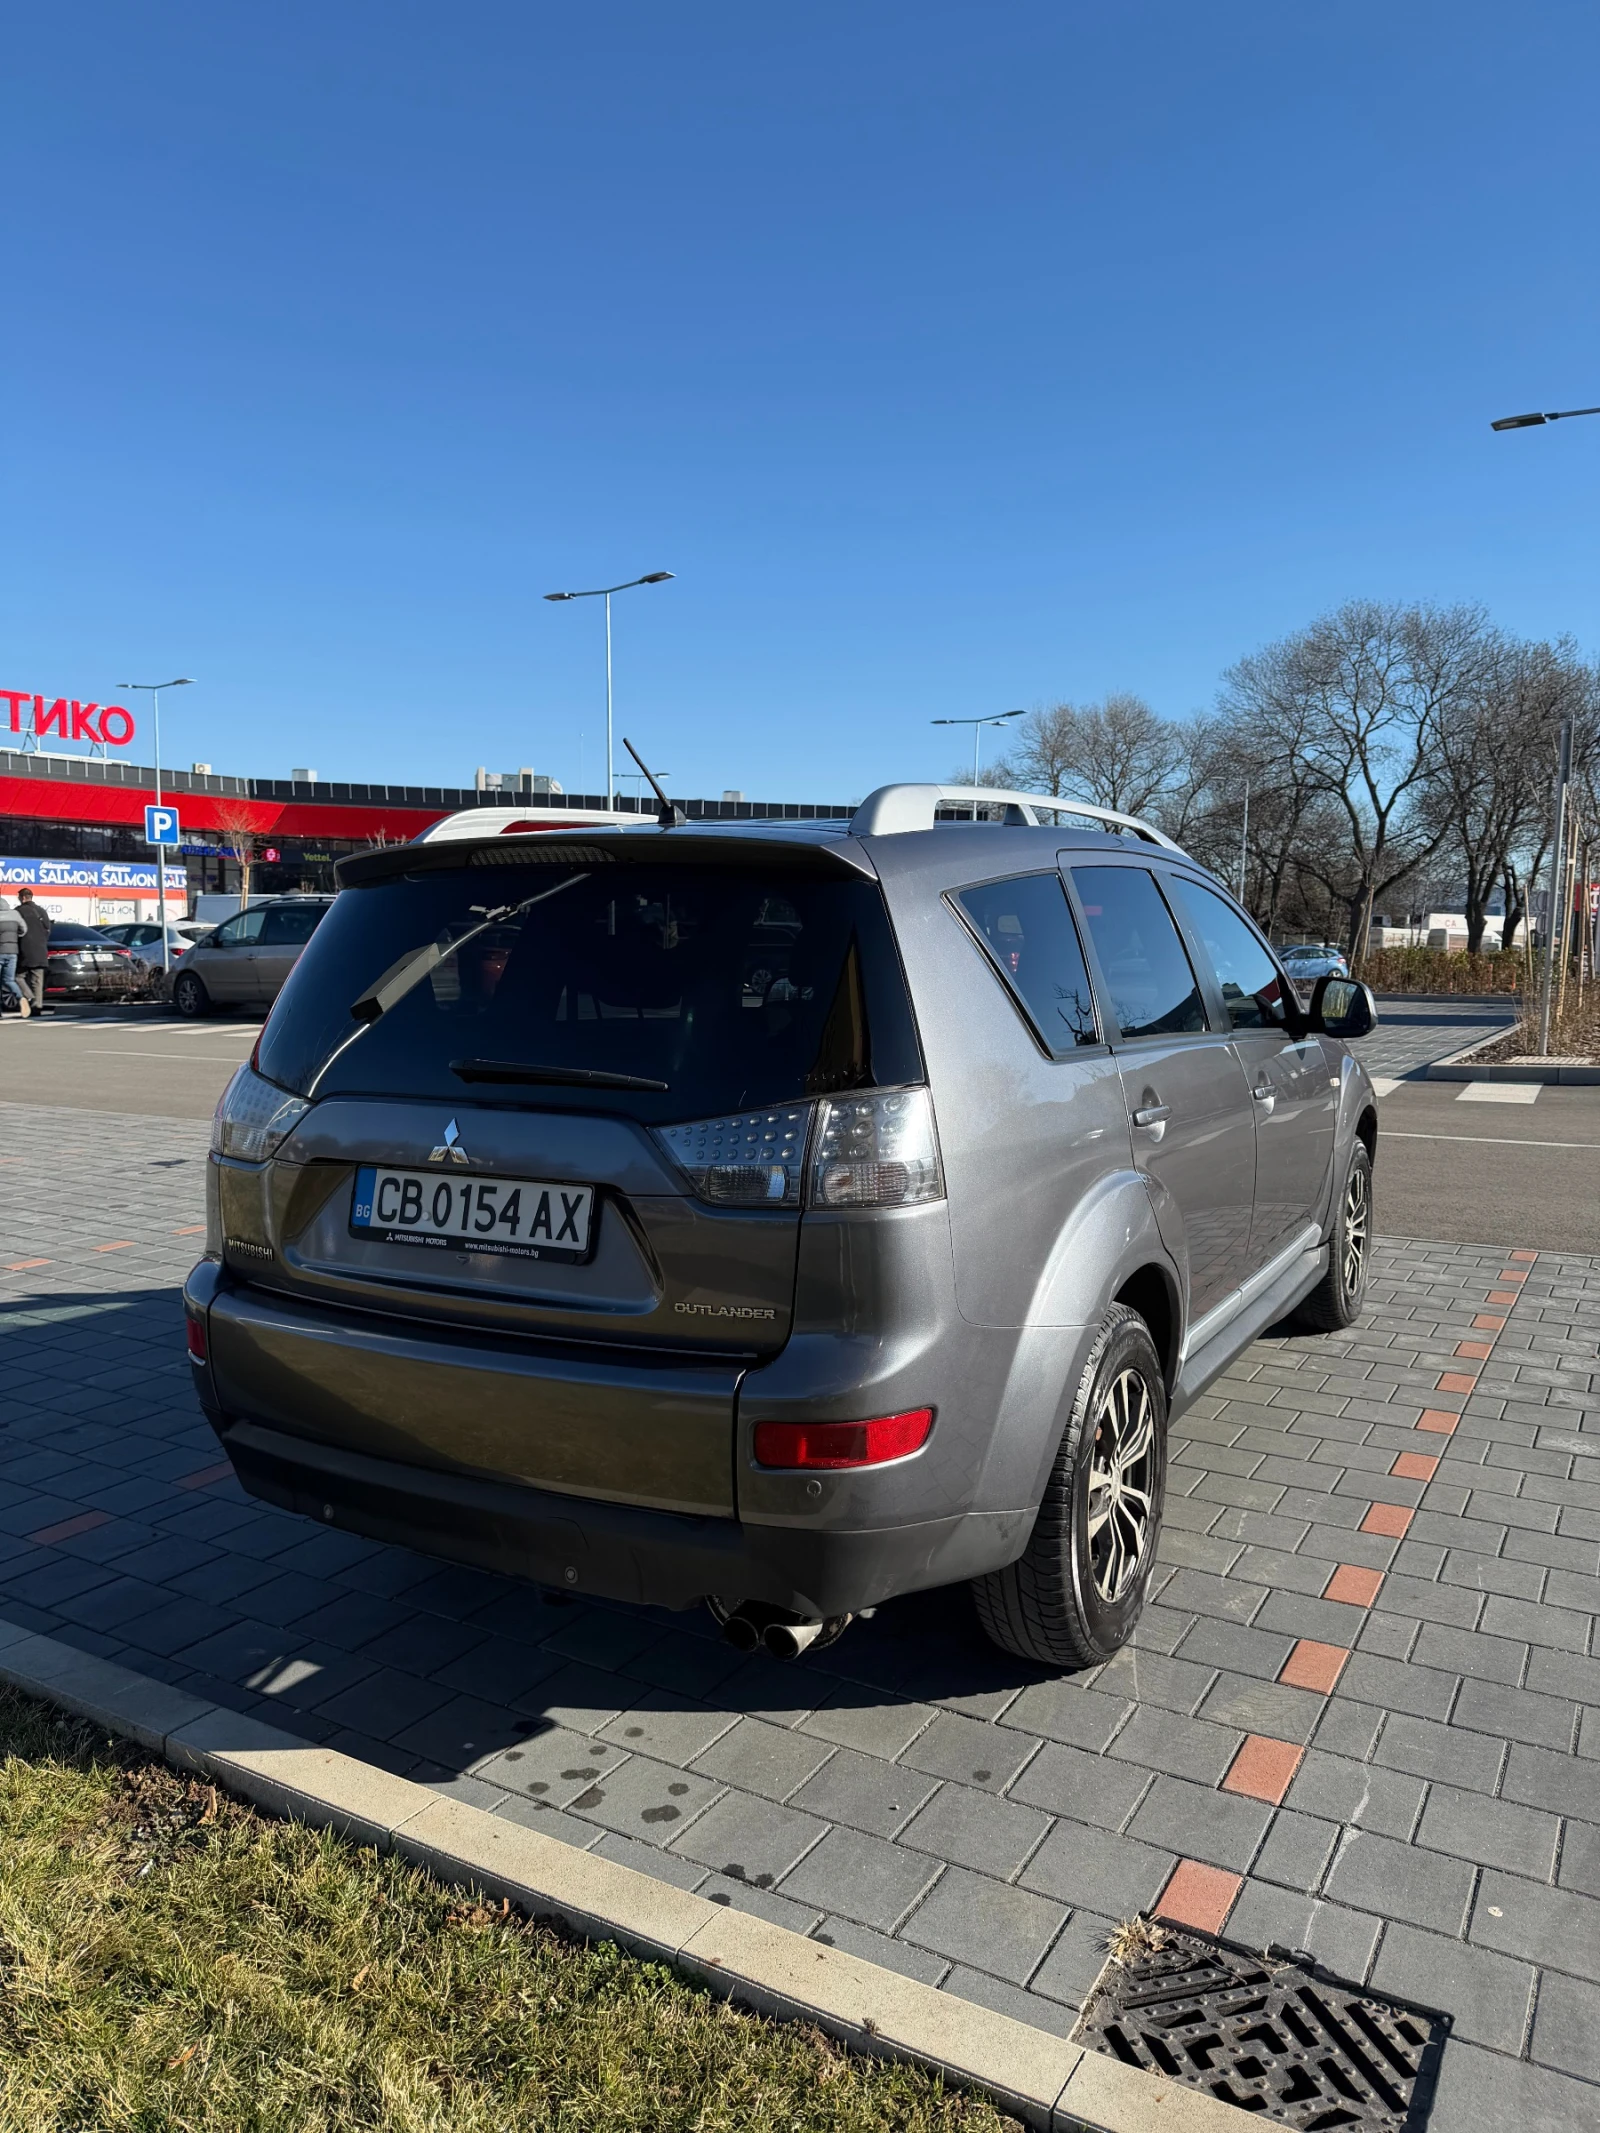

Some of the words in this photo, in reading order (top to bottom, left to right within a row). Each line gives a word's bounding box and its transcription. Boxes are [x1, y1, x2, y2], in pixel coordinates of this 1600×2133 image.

[0, 689, 135, 746] ТИКО
[154, 811, 172, 840] P
[39, 868, 98, 885] SALMON
[101, 871, 157, 887] SALMON
[356, 1204, 370, 1218] BG
[377, 1177, 423, 1225] CB
[432, 1182, 521, 1236] 0154
[529, 1190, 584, 1243] AX
[228, 1238, 273, 1260] MITSUBISHI
[394, 1233, 424, 1244] MITSUBISHI
[425, 1236, 447, 1246] MOTORS
[464, 1241, 539, 1258] www.mitsubishi-motors.bg
[674, 1302, 775, 1319] OUTLANDER
